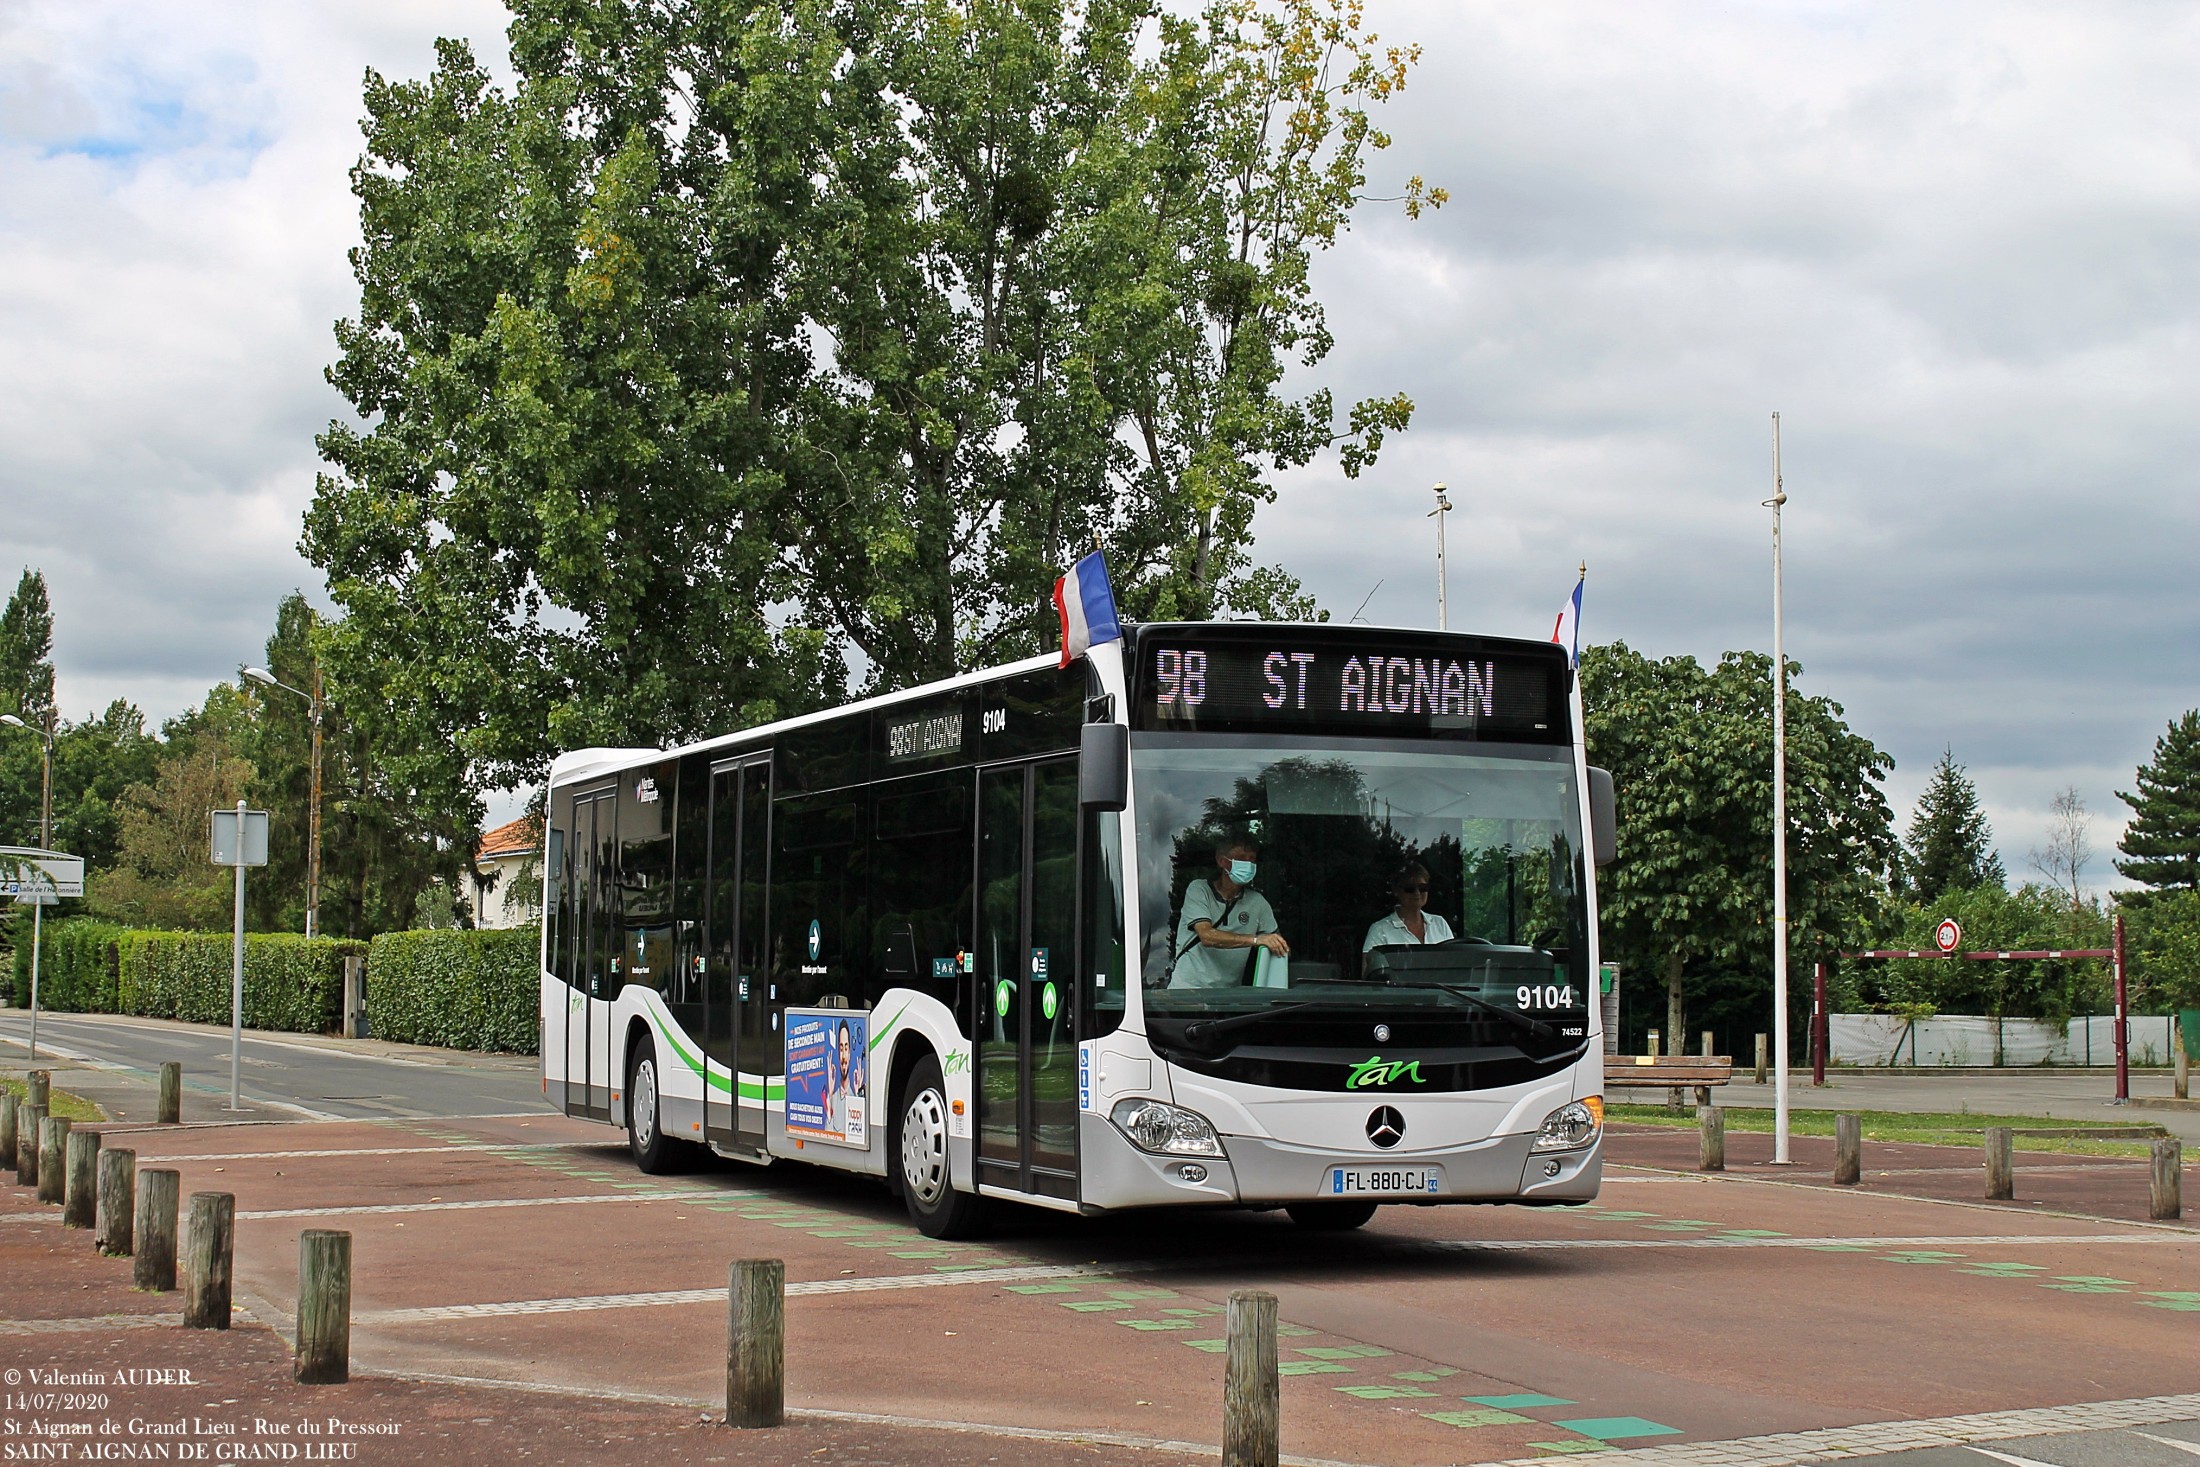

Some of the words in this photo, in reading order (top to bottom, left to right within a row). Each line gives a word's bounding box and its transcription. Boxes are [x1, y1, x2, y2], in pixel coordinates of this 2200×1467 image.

[1156, 649, 1207, 706] 98
[1262, 651, 1315, 710] ST
[1340, 654, 1494, 717] AIGNAN
[982, 707, 1006, 734] 9104
[1516, 985, 1573, 1010] 9104
[1561, 1027, 1583, 1037] 74522
[943, 1047, 971, 1077] tan
[1346, 1056, 1427, 1089] tan
[1346, 1172, 1425, 1190] FL-880-CJ
[1428, 1180, 1438, 1189] 44
